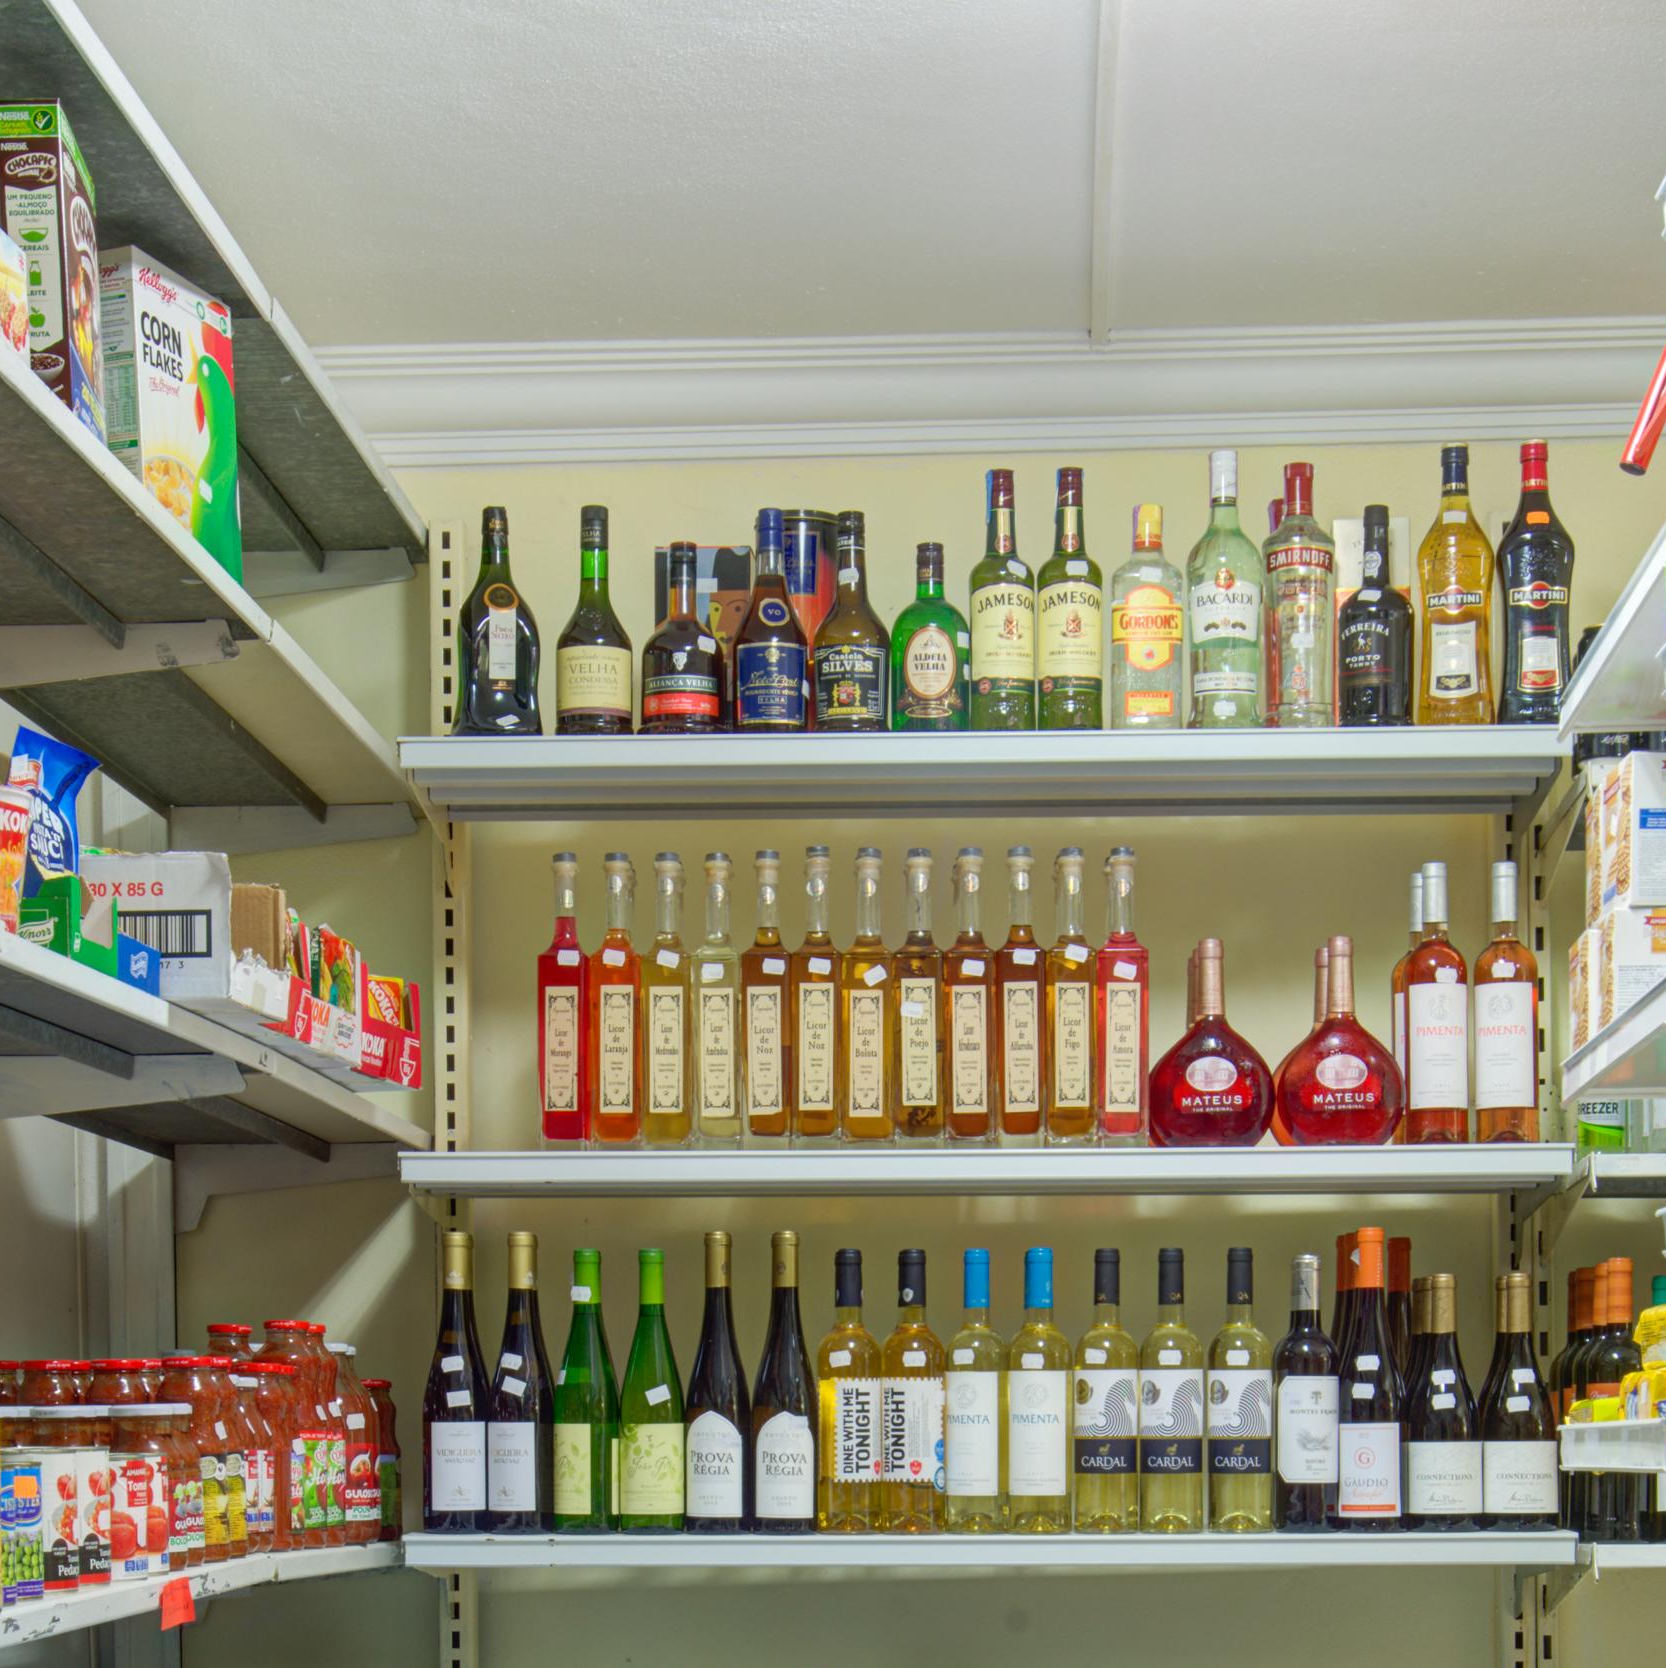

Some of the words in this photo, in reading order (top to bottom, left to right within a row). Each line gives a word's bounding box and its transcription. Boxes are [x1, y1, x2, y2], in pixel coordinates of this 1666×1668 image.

[7, 153, 55, 173] CHOCAPIC
[8, 209, 54, 217] EQUILIBRADO
[139, 268, 178, 302] Kellogg's
[141, 311, 181, 358] CORN
[143, 345, 183, 382] FLAKES
[1269, 550, 1332, 569] SMIRNOFF
[977, 593, 1034, 613] JAMESON
[1041, 591, 1101, 612] JAMESON
[1196, 593, 1253, 608] BACARDI
[1428, 591, 1482, 608] MARTINI
[1341, 621, 1390, 643] FERREIRA
[822, 658, 874, 673] SILVES
[913, 653, 947, 663] ALDEIA
[1346, 654, 1381, 665] PORTO
[569, 661, 618, 675] VELHA
[914, 662, 946, 671] VELHA
[648, 678, 685, 691] ALIANÇA
[687, 679, 714, 691] VELHA
[112, 882, 123, 897] X
[127, 881, 146, 897] 85
[150, 881, 164, 896] G
[1415, 1025, 1465, 1038] PIMENTA
[362, 1032, 386, 1057] KOKA
[808, 1041, 825, 1050] Noz
[1065, 1038, 1080, 1050] Figo
[1182, 1094, 1243, 1107] MATEUS
[1313, 1091, 1375, 1105] MATEUS
[843, 1387, 854, 1411] ME
[843, 1413, 854, 1442] WITH
[855, 1387, 871, 1474] TONIGHT
[890, 1386, 905, 1473] TONIGHT
[691, 1450, 733, 1464] PROVA
[762, 1450, 807, 1464] PROVA
[843, 1444, 854, 1474] DINE
[1081, 1454, 1127, 1471] CARDAL
[693, 1461, 730, 1476] RÉGIA
[765, 1462, 804, 1477] RÉGIA
[1344, 1476, 1388, 1489] GAUDIO
[1495, 1472, 1553, 1481] CONNECTIONS
